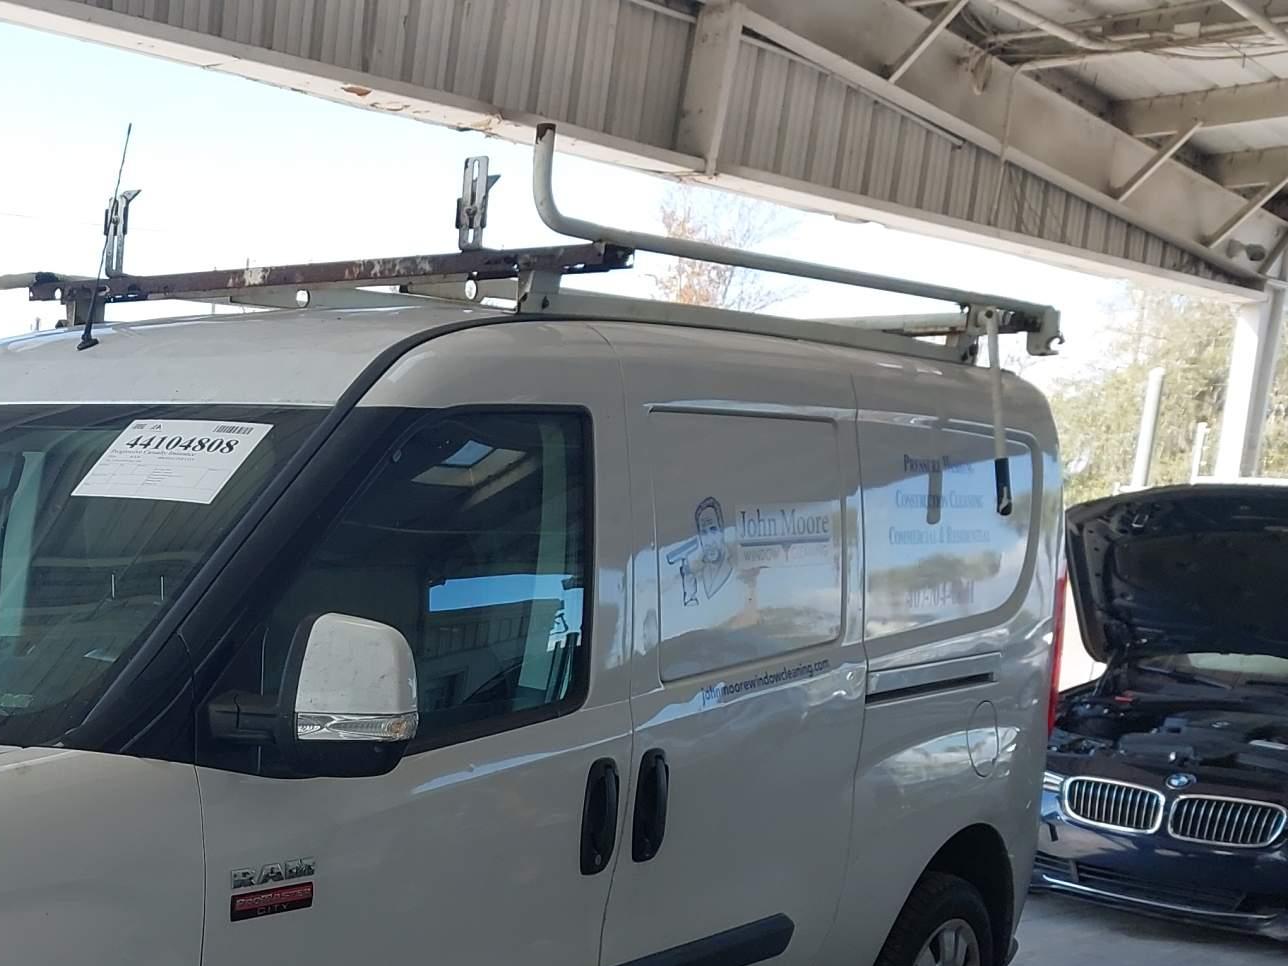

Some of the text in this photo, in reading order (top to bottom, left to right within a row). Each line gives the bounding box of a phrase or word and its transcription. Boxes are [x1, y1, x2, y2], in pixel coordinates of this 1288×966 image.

[125, 434, 240, 455] 44104808
[739, 508, 830, 538] John Moore
[701, 659, 830, 706] johnmoorewindowcleaning.com
[230, 857, 316, 889] RAM
[256, 903, 290, 916] CITY
